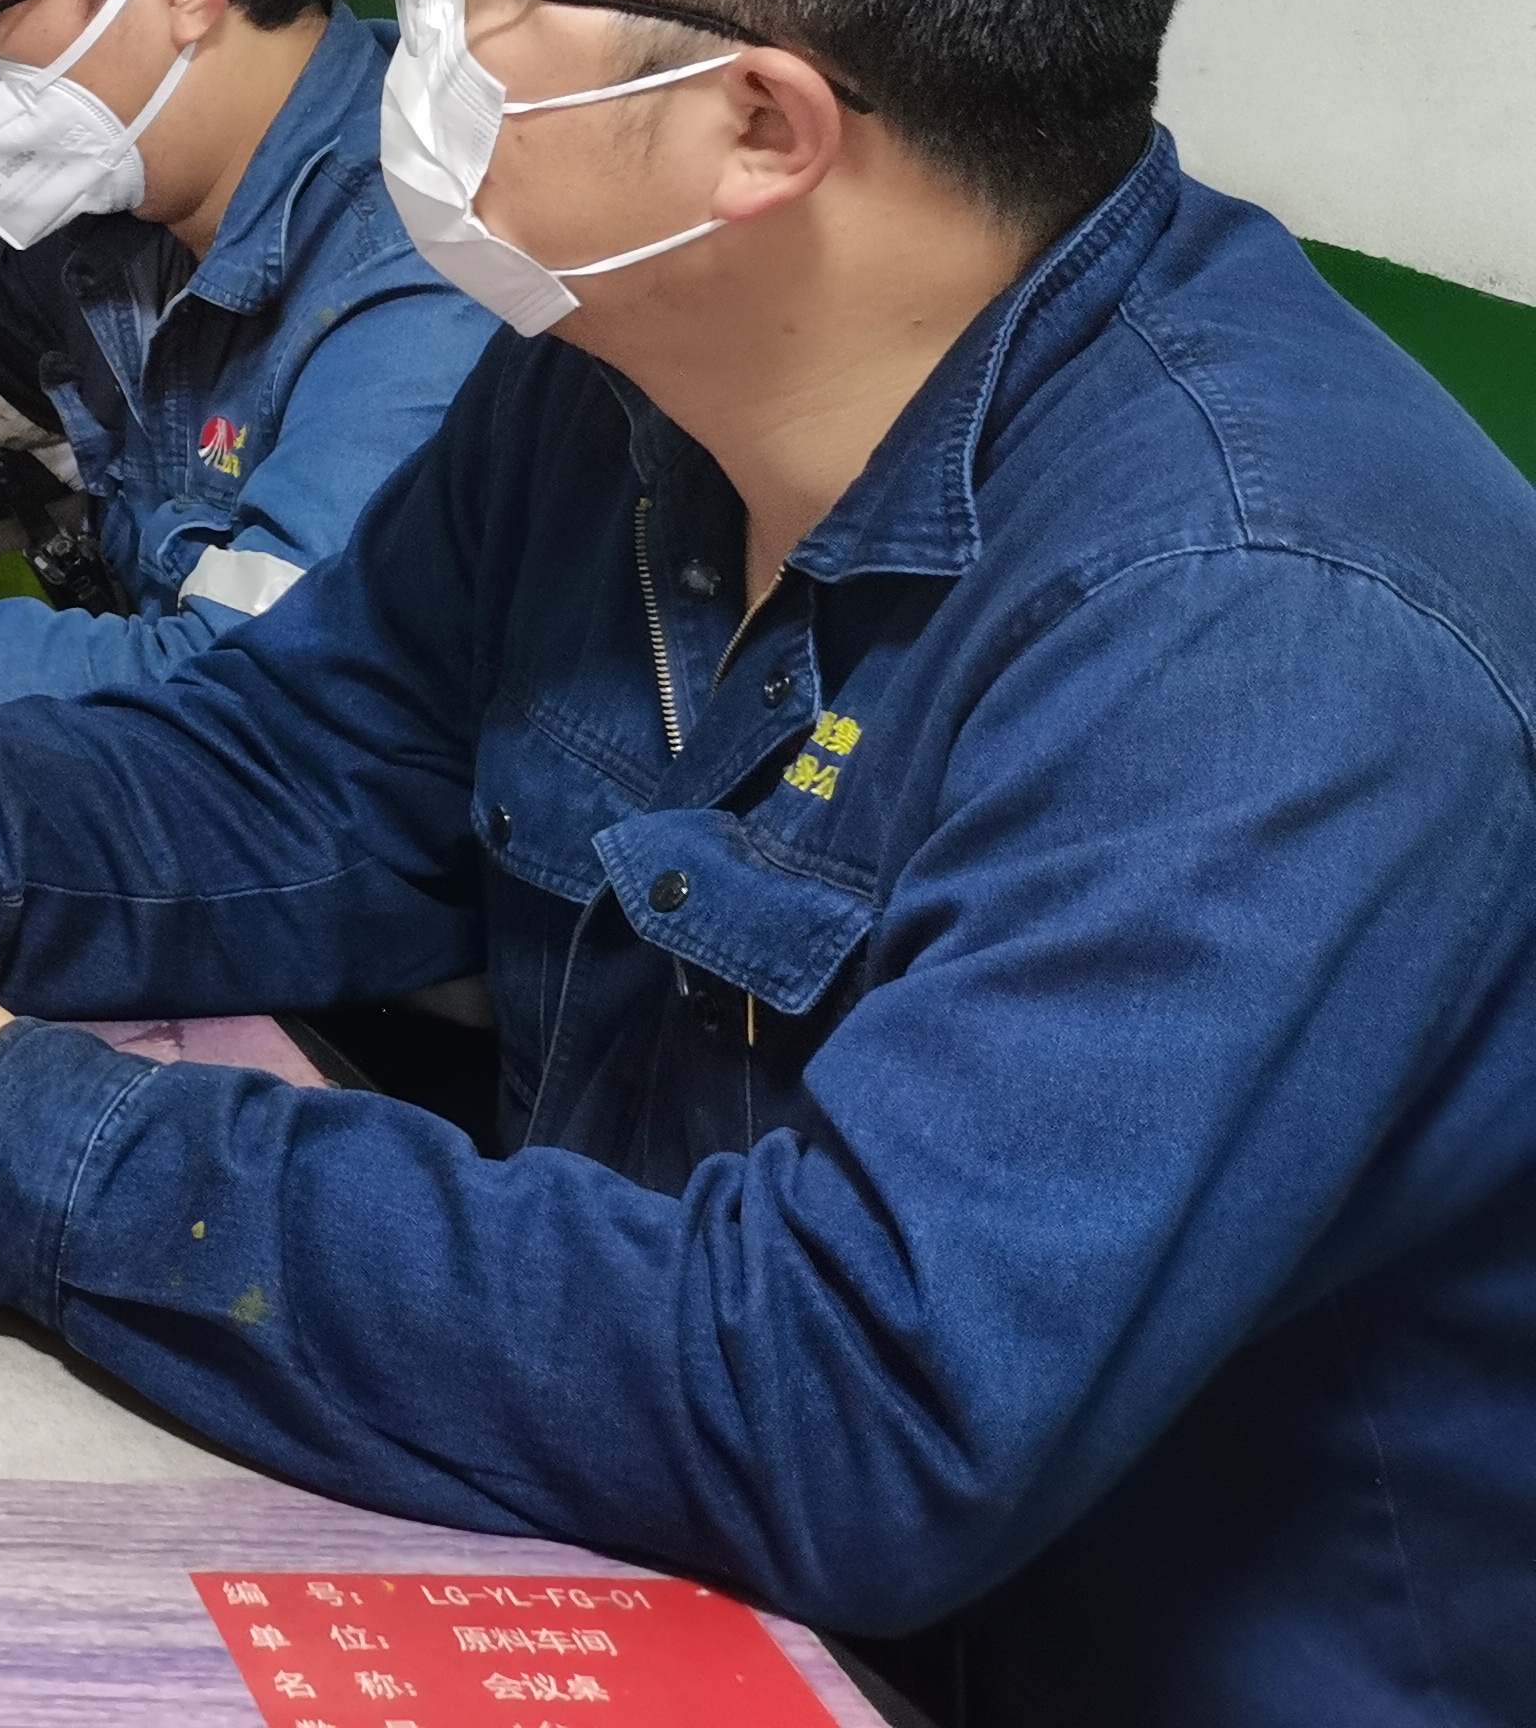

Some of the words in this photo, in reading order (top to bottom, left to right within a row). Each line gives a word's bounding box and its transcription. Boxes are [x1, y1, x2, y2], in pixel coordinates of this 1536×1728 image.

[420, 1585, 651, 1610] LG-YL-FG-01
[453, 1626, 618, 1656] 原料车间
[483, 1672, 610, 1703] 会议桌
